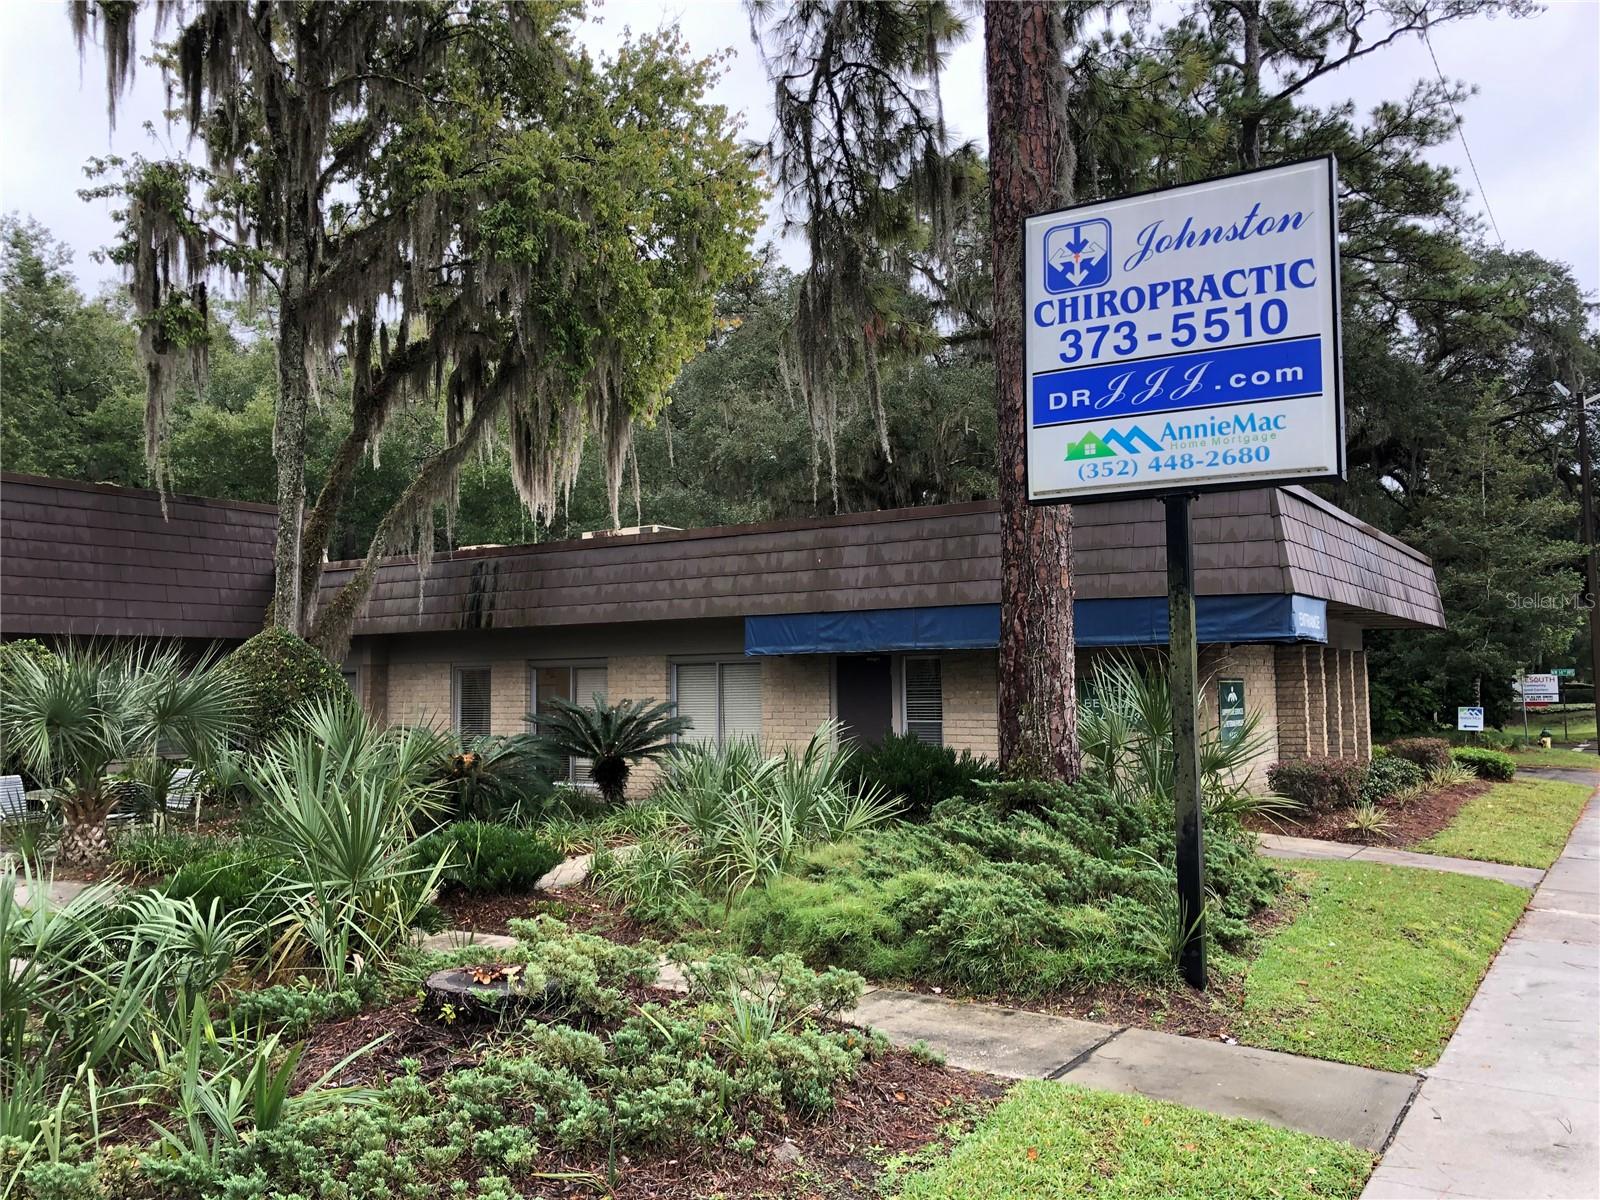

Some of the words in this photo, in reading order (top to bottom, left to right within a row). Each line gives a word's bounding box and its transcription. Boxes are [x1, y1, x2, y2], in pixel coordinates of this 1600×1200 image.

[1123, 202, 1314, 272] Johnston
[1033, 258, 1318, 328] CHIROPRACTIC
[1059, 298, 1289, 364] 373-5510
[1160, 412, 1288, 442] AnnieMac
[1170, 437, 1208, 450] Home
[1211, 431, 1278, 447] Mortgage
[1078, 458, 1139, 482] (352)
[1148, 444, 1271, 473] 448-2680
